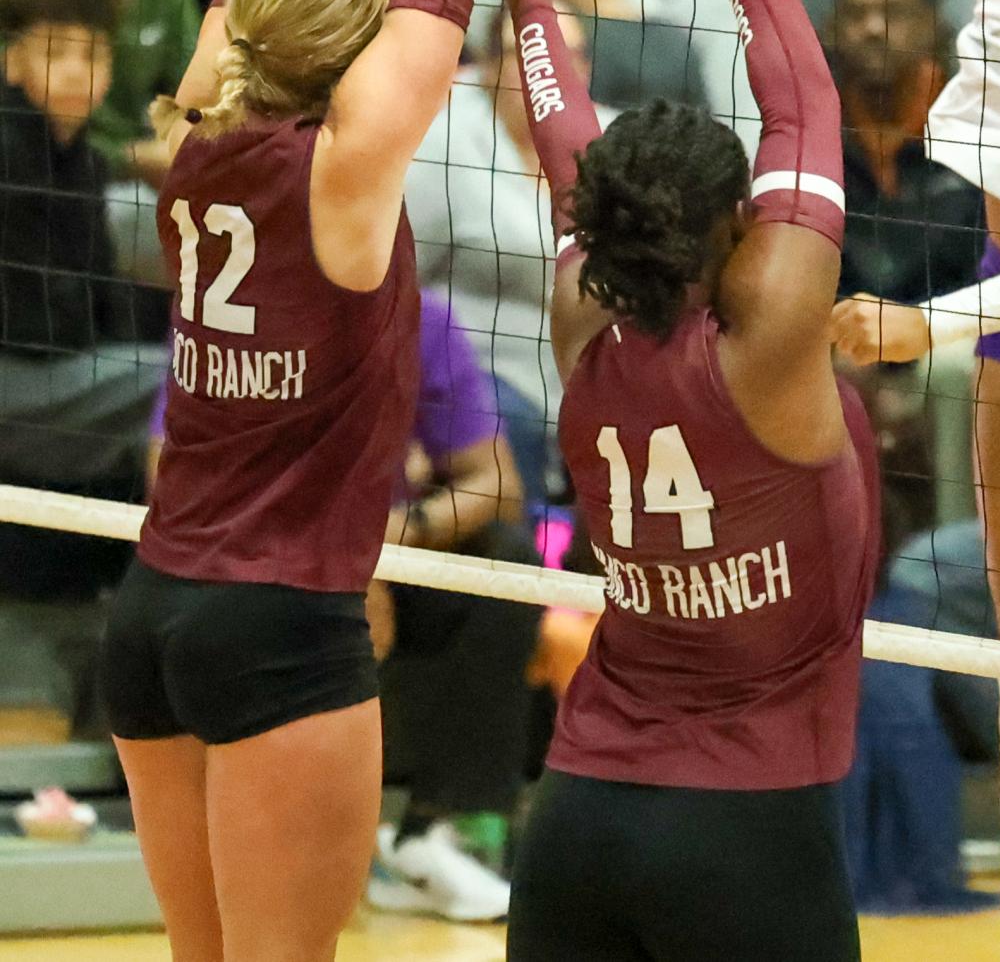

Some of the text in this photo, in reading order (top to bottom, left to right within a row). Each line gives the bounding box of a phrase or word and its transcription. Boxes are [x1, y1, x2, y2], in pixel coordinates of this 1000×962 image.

[520, 22, 565, 123] COUGARS
[170, 198, 256, 335] 12
[206, 344, 307, 400] RANCH
[596, 424, 715, 550] 14
[658, 540, 792, 619] RANCH
